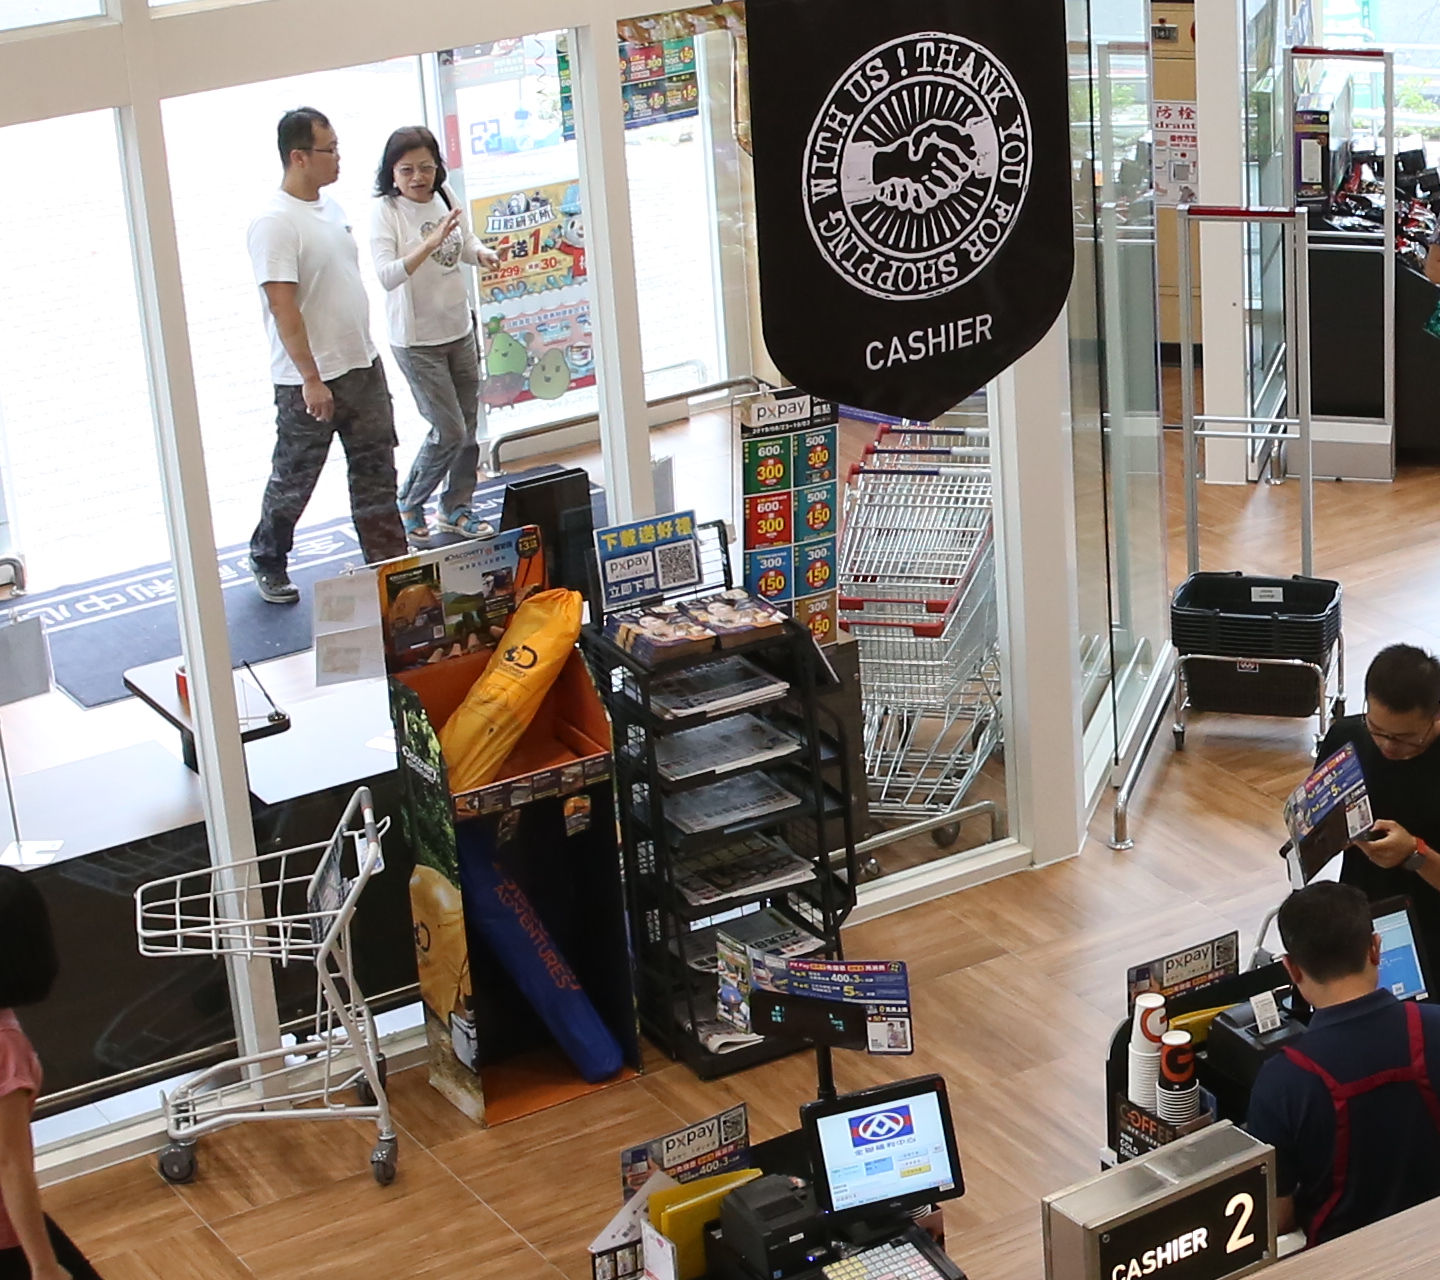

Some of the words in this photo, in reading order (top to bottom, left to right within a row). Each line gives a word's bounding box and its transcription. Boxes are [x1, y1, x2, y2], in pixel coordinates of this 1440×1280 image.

[915, 40, 1014, 117] THANK
[811, 103, 855, 204] WITH
[998, 114, 1026, 189] YOU
[960, 193, 1015, 263] FOR
[818, 210, 959, 292] SHOPPING
[865, 313, 994, 371] CASHIER
[757, 400, 808, 422] pxpay
[756, 463, 785, 480] 300
[808, 450, 830, 464] 300
[757, 517, 785, 534] 300
[806, 510, 831, 524] 150
[601, 516, 694, 552] 下載送好禮
[609, 553, 651, 575] pxpay
[806, 566, 831, 582] 150
[758, 575, 786, 592] 150
[1164, 946, 1211, 974] pxpay
[664, 1119, 717, 1154] pxpay
[1224, 1192, 1256, 1254] 2
